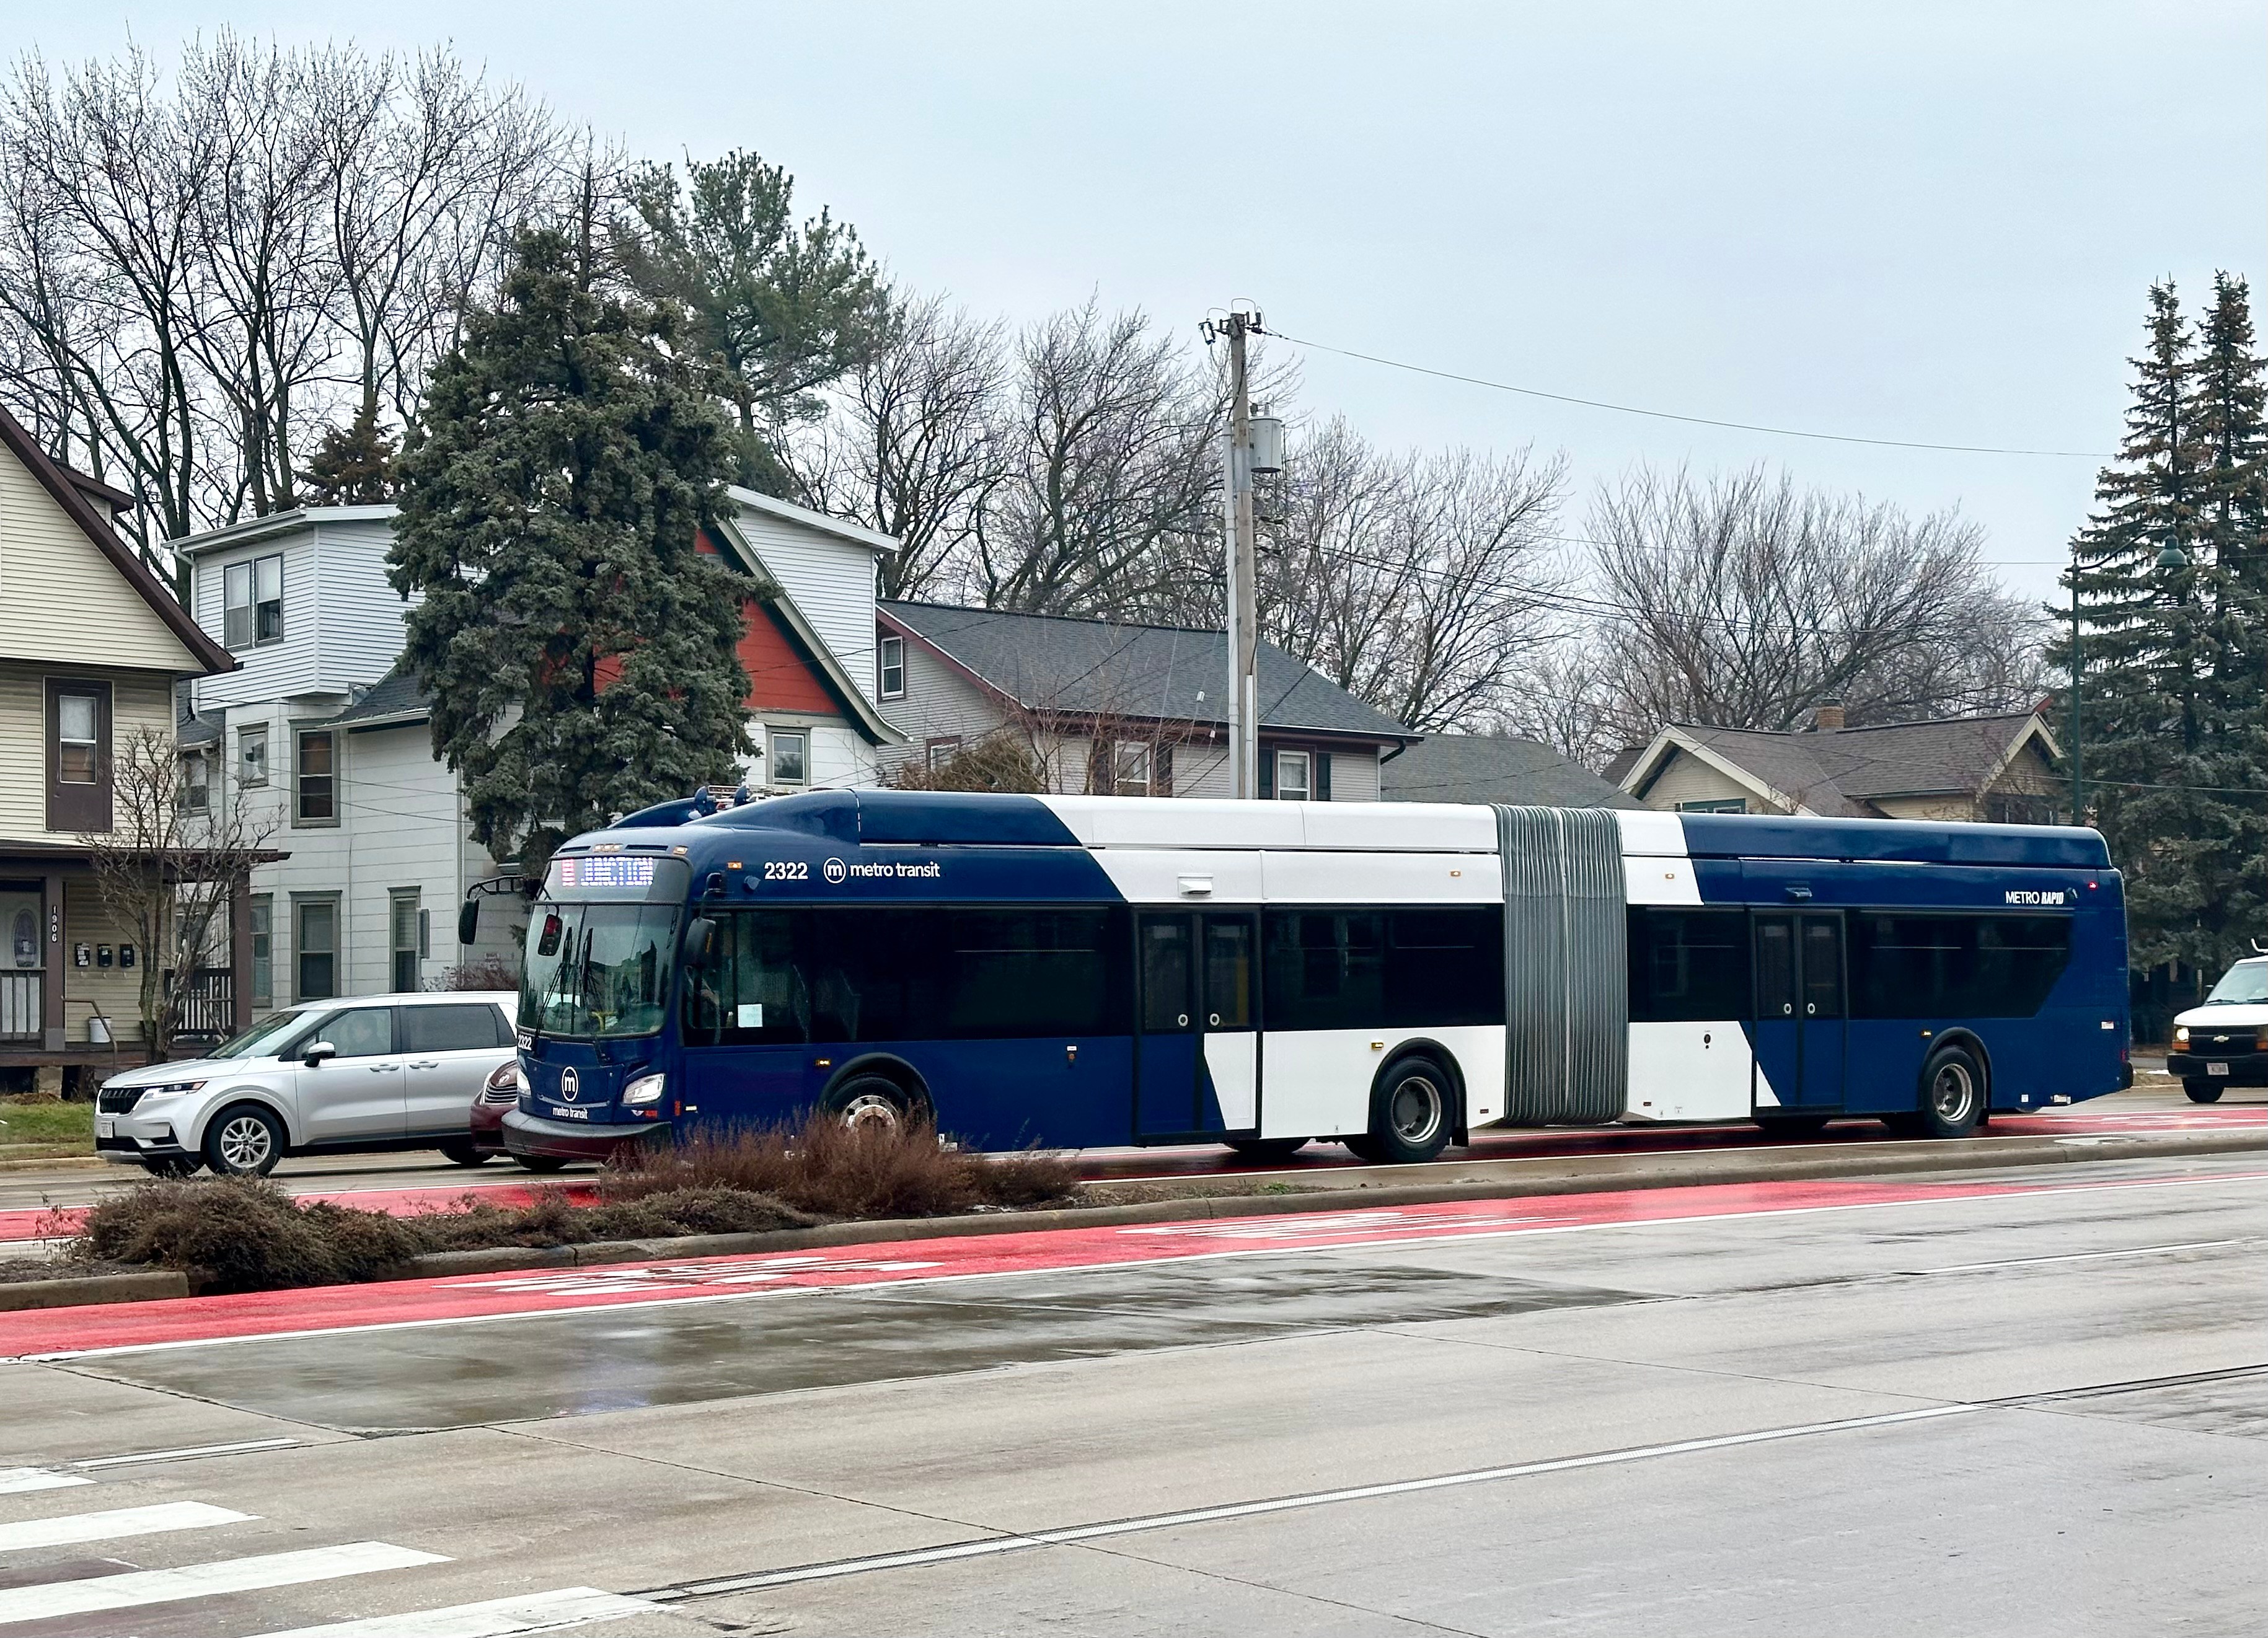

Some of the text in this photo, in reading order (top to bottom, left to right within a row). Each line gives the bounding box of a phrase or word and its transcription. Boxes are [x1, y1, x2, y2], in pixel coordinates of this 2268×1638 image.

[764, 861, 808, 879] 2322
[850, 862, 893, 877] metro
[896, 861, 940, 877] transit
[2005, 891, 2064, 904] METRO RAPID
[518, 1034, 532, 1050] 2322
[552, 1107, 588, 1119] metro transit
